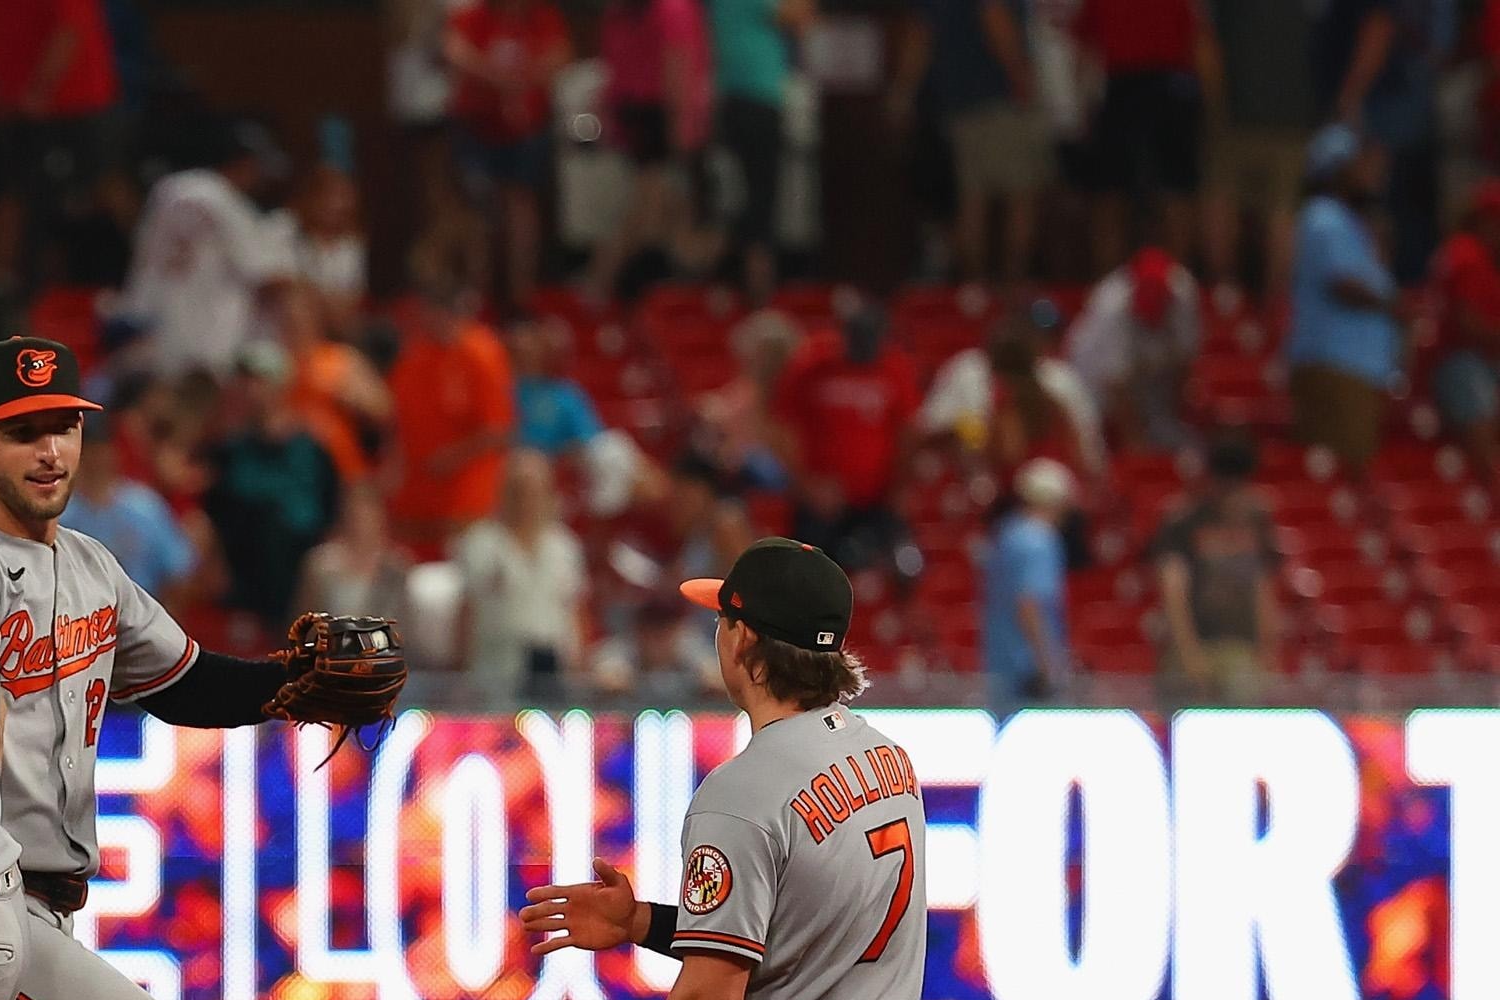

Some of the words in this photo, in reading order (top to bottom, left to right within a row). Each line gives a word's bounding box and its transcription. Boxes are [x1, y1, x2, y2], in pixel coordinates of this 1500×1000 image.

[85, 678, 106, 748] 2
[790, 745, 919, 845] HOLLIDA
[854, 817, 914, 965] 7
